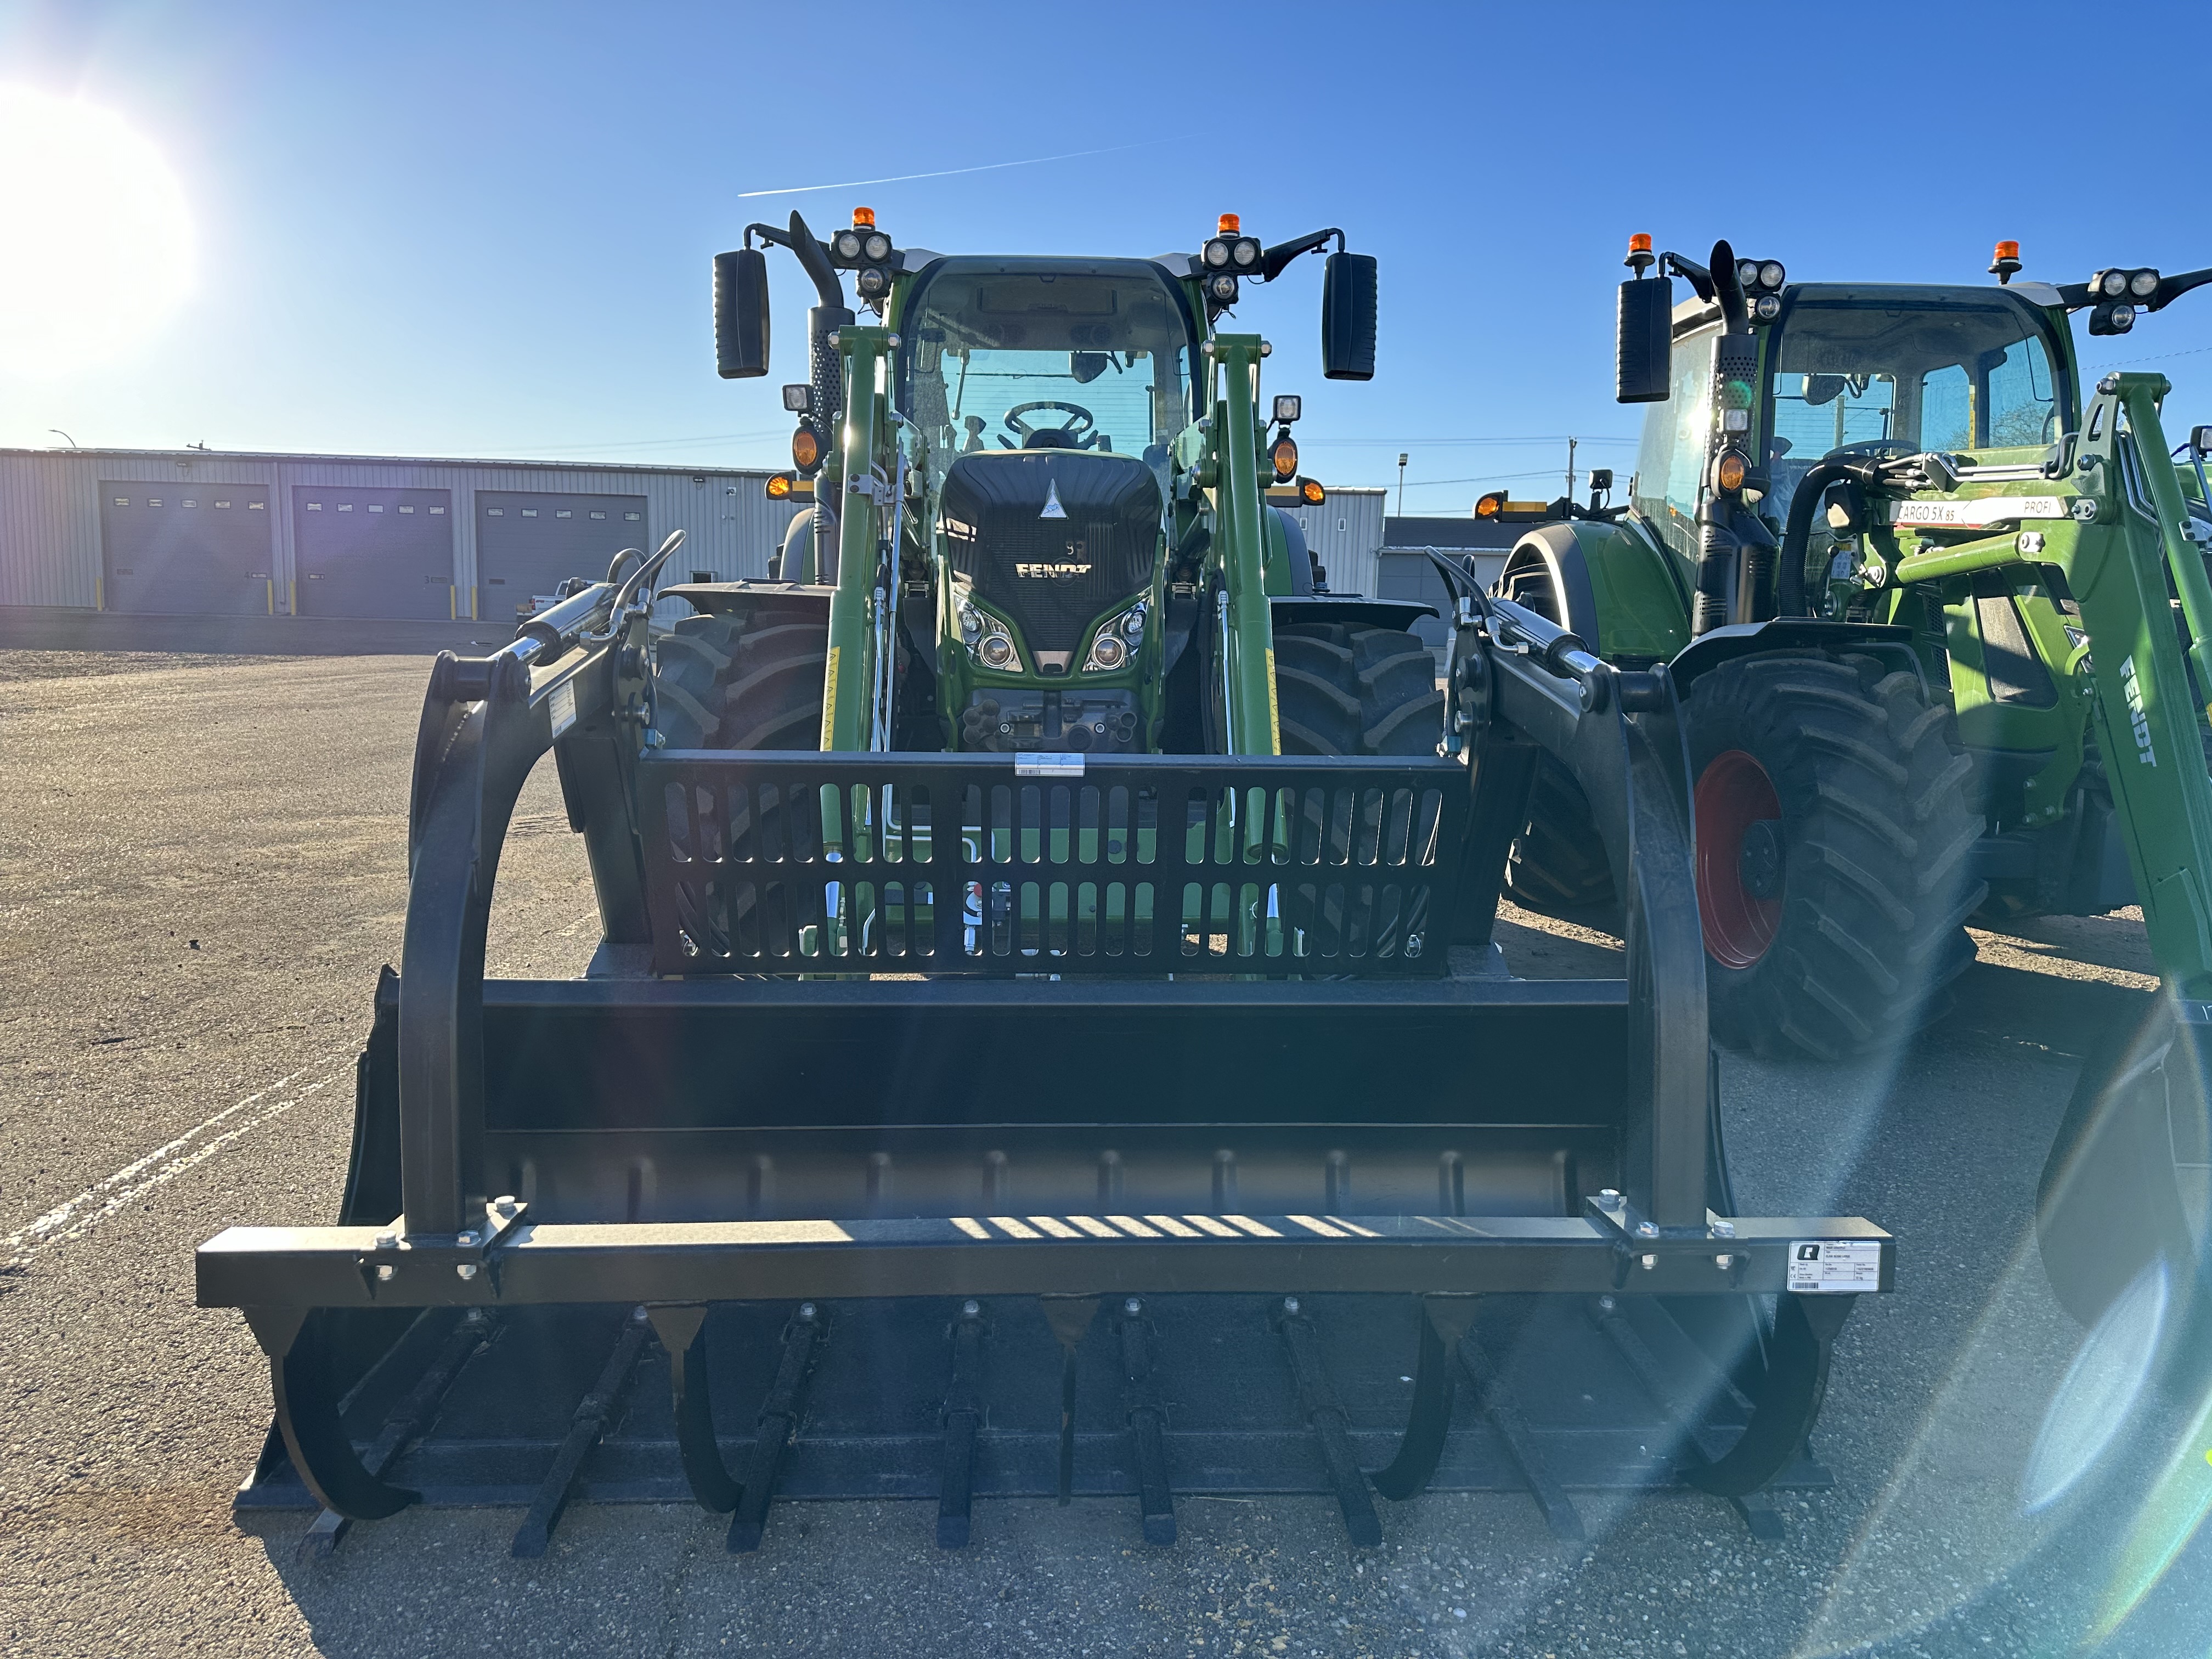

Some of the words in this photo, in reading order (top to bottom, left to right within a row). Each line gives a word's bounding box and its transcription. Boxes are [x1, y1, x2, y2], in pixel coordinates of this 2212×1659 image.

[1931, 506, 1944, 520] 5X
[1945, 510, 1954, 521] 85
[2024, 501, 2051, 514] PROFI
[1015, 563, 1092, 578] FENDT
[424, 575, 430, 584] 3
[2119, 654, 2157, 767] FENDT
